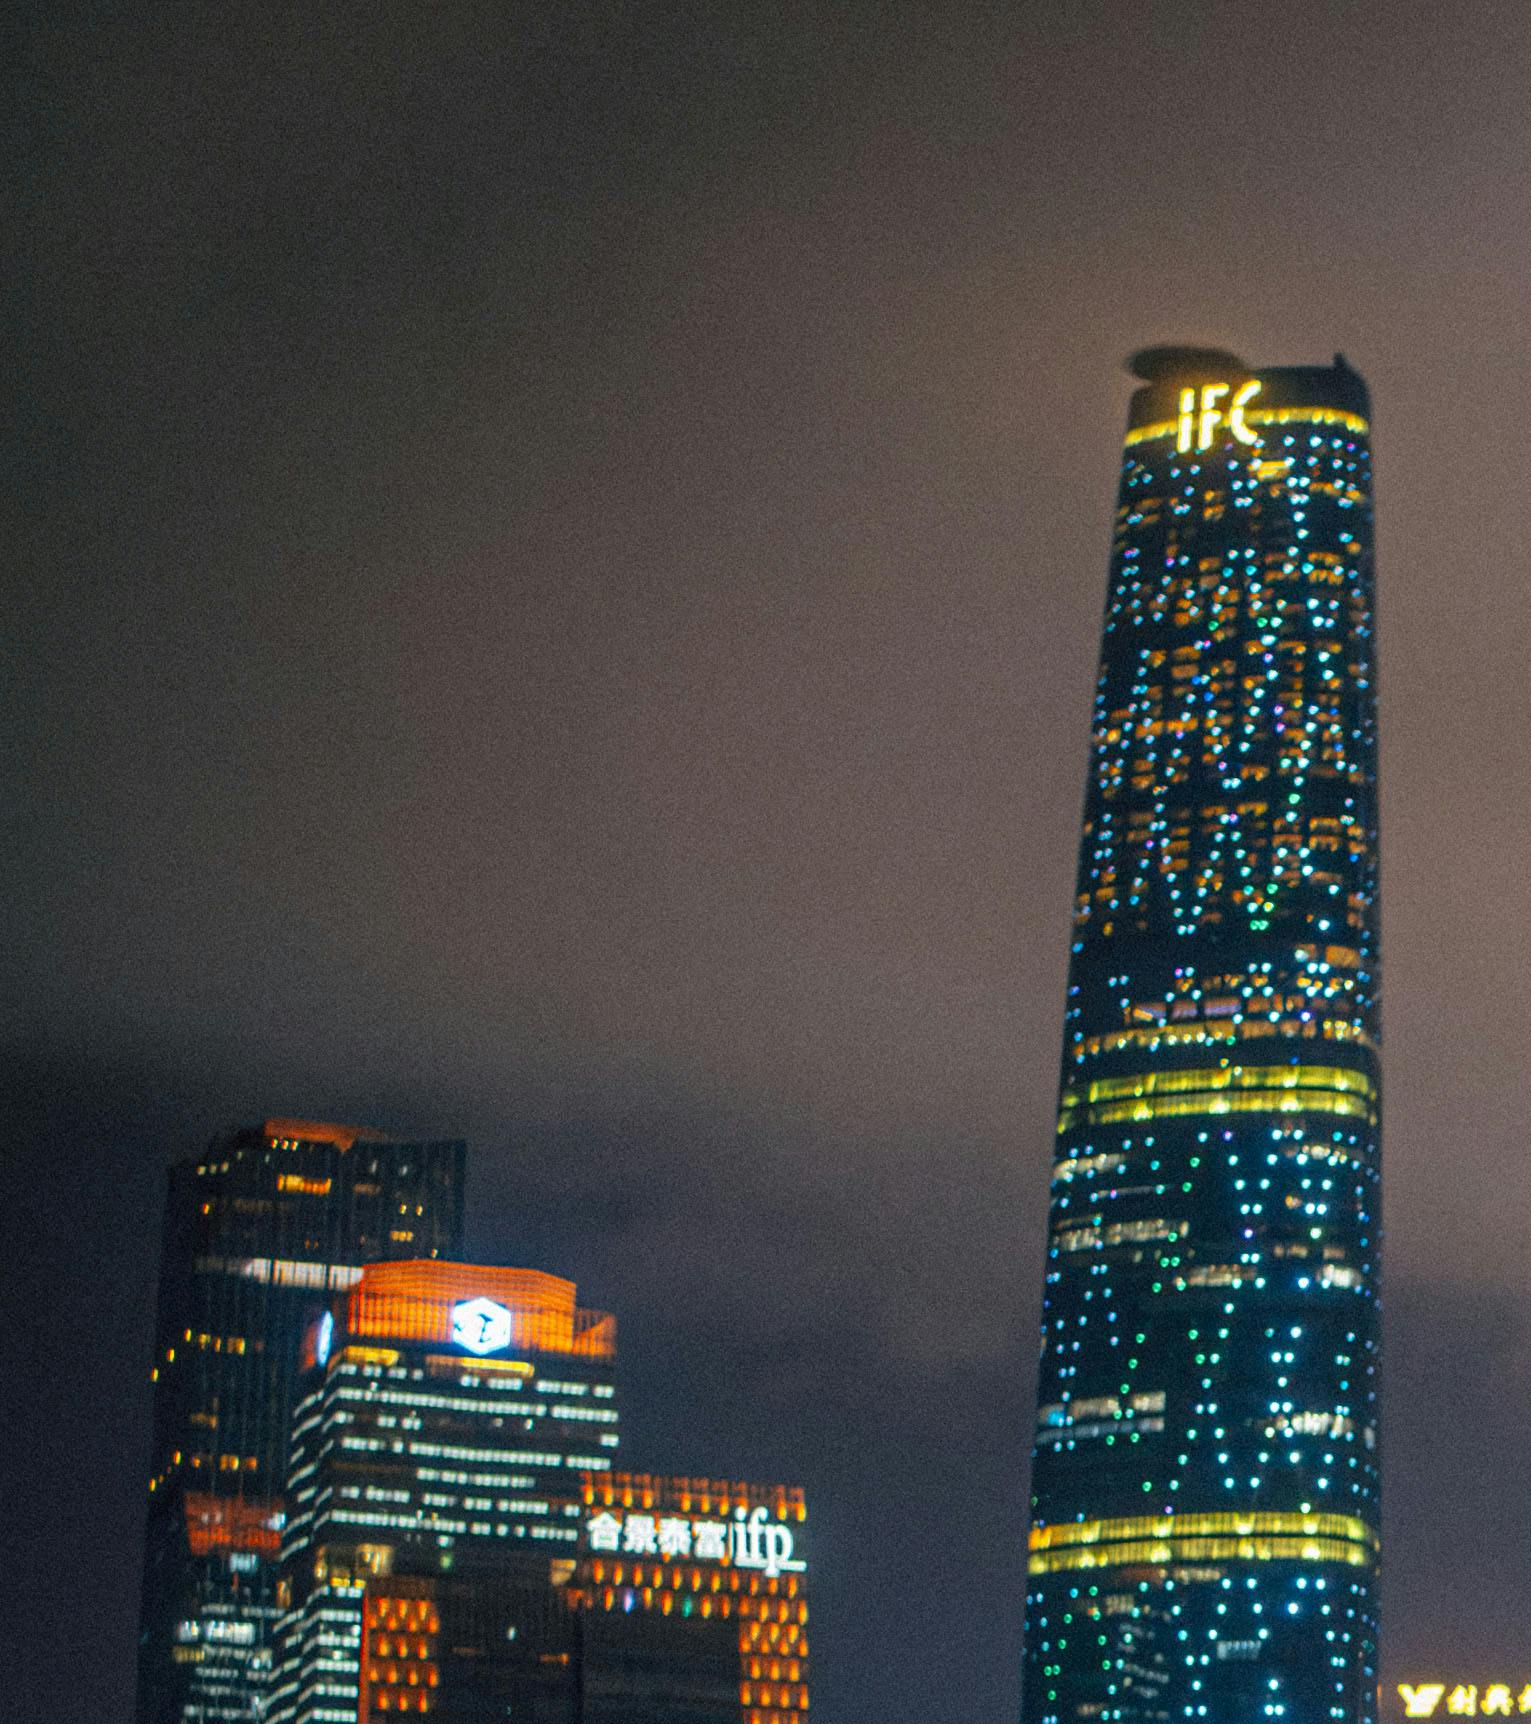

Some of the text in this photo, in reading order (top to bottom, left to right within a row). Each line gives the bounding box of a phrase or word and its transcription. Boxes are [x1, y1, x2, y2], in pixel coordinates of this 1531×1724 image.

[1177, 380, 1263, 453] IFC
[587, 1505, 798, 1578] 合景泰富 ifp
